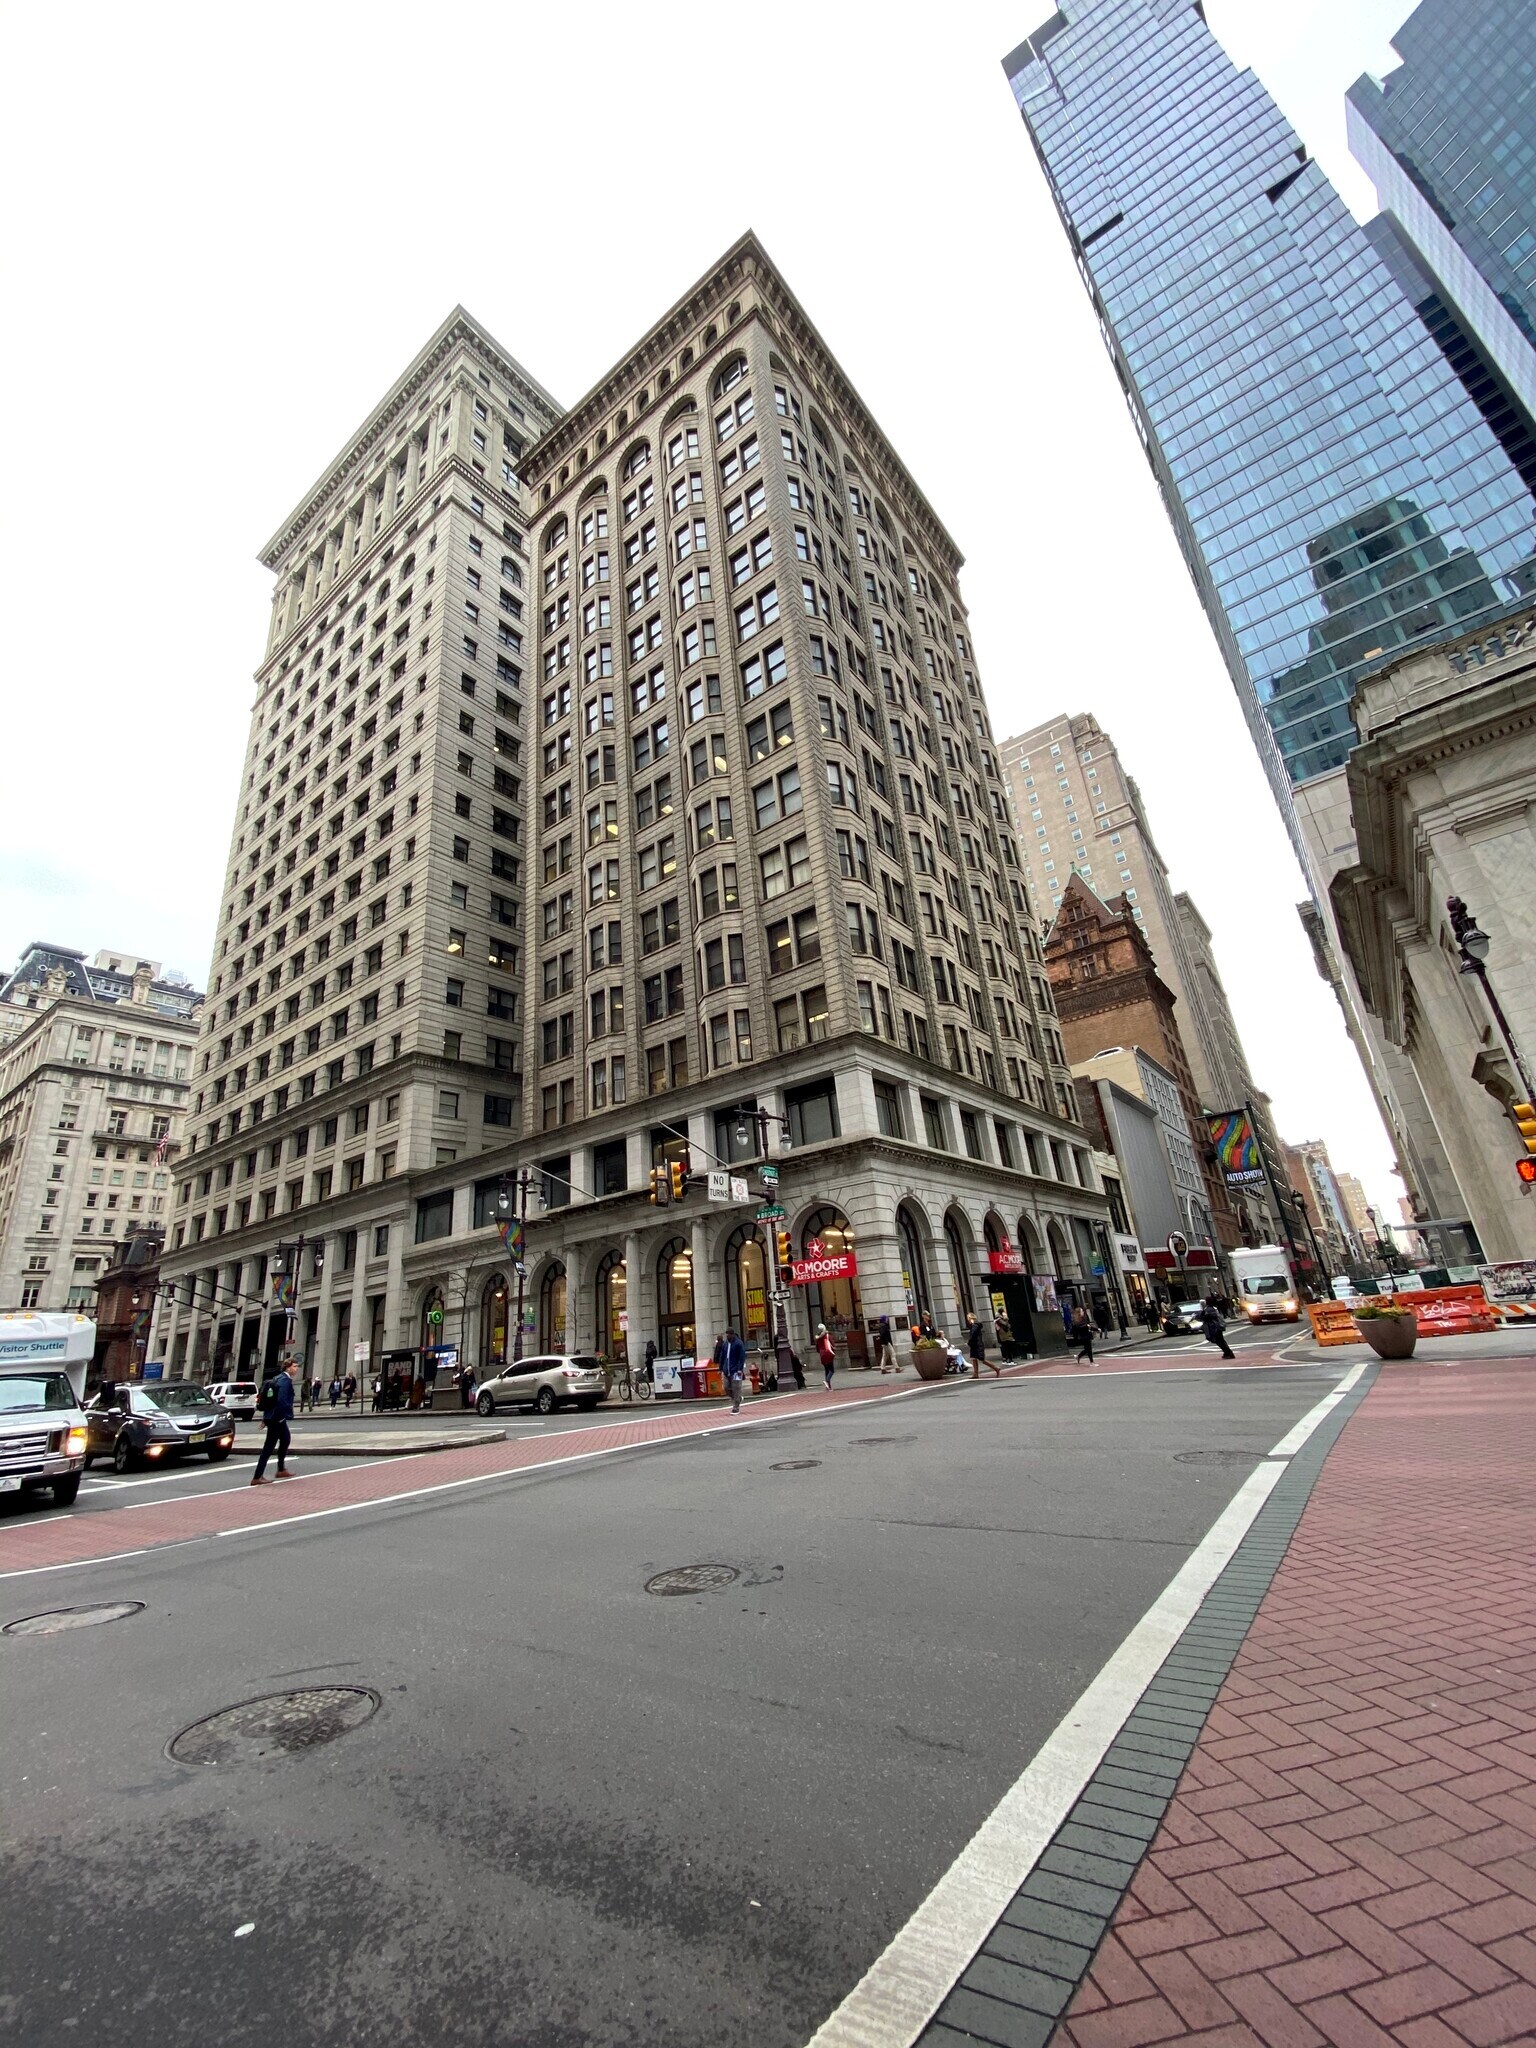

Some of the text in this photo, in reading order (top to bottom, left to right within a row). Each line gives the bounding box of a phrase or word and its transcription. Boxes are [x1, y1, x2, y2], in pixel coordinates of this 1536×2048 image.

[713, 1175, 724, 1186] NO
[1226, 1169, 1263, 1182] AUTO SHOW
[709, 1188, 729, 1198] TURNS
[761, 1210, 779, 1219] BROAD
[797, 1273, 811, 1281] ARTS
[815, 1270, 840, 1278] CRAFTS
[0, 1342, 65, 1353] Visitor Shuttle
